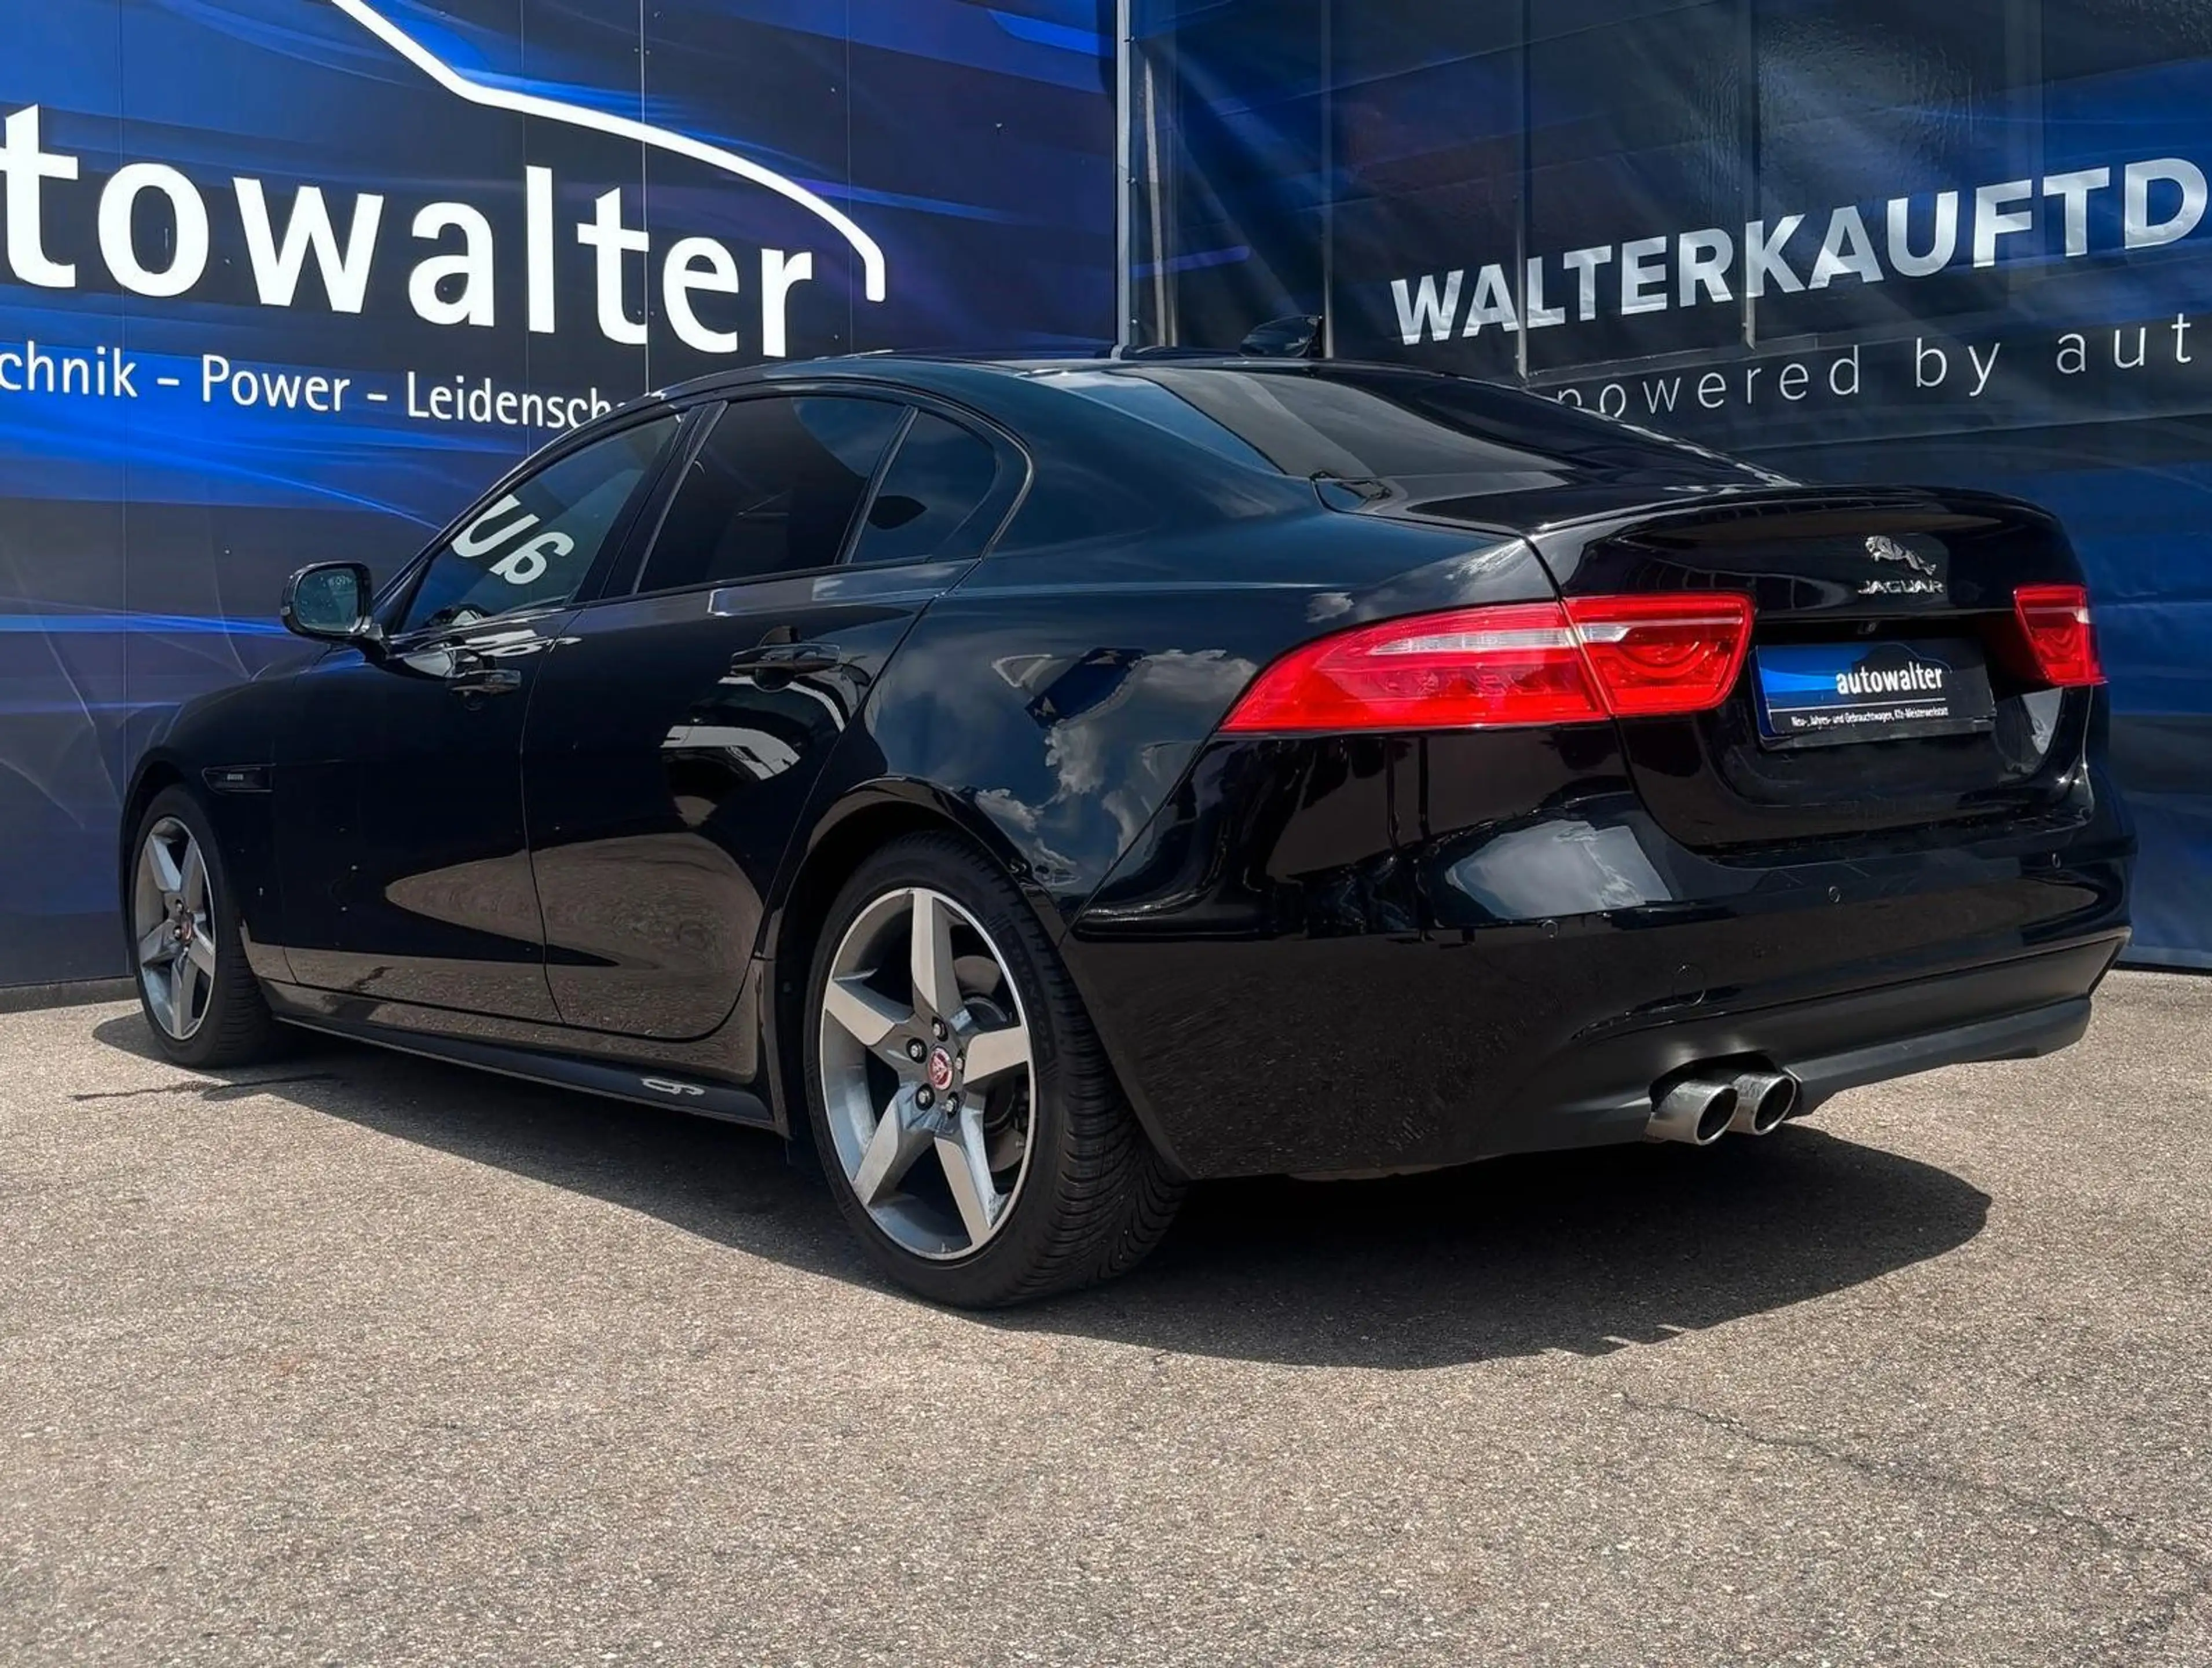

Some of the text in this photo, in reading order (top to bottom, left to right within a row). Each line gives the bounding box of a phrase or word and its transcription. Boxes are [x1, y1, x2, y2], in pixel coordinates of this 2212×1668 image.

[1390, 158, 2208, 345] WALTERKAUFTD
[203, 354, 350, 412] Power
[1916, 338, 2000, 396] by
[2056, 313, 2191, 374] aut
[1857, 579, 1944, 595] JAGUAR
[1835, 661, 1943, 695] autowalter
